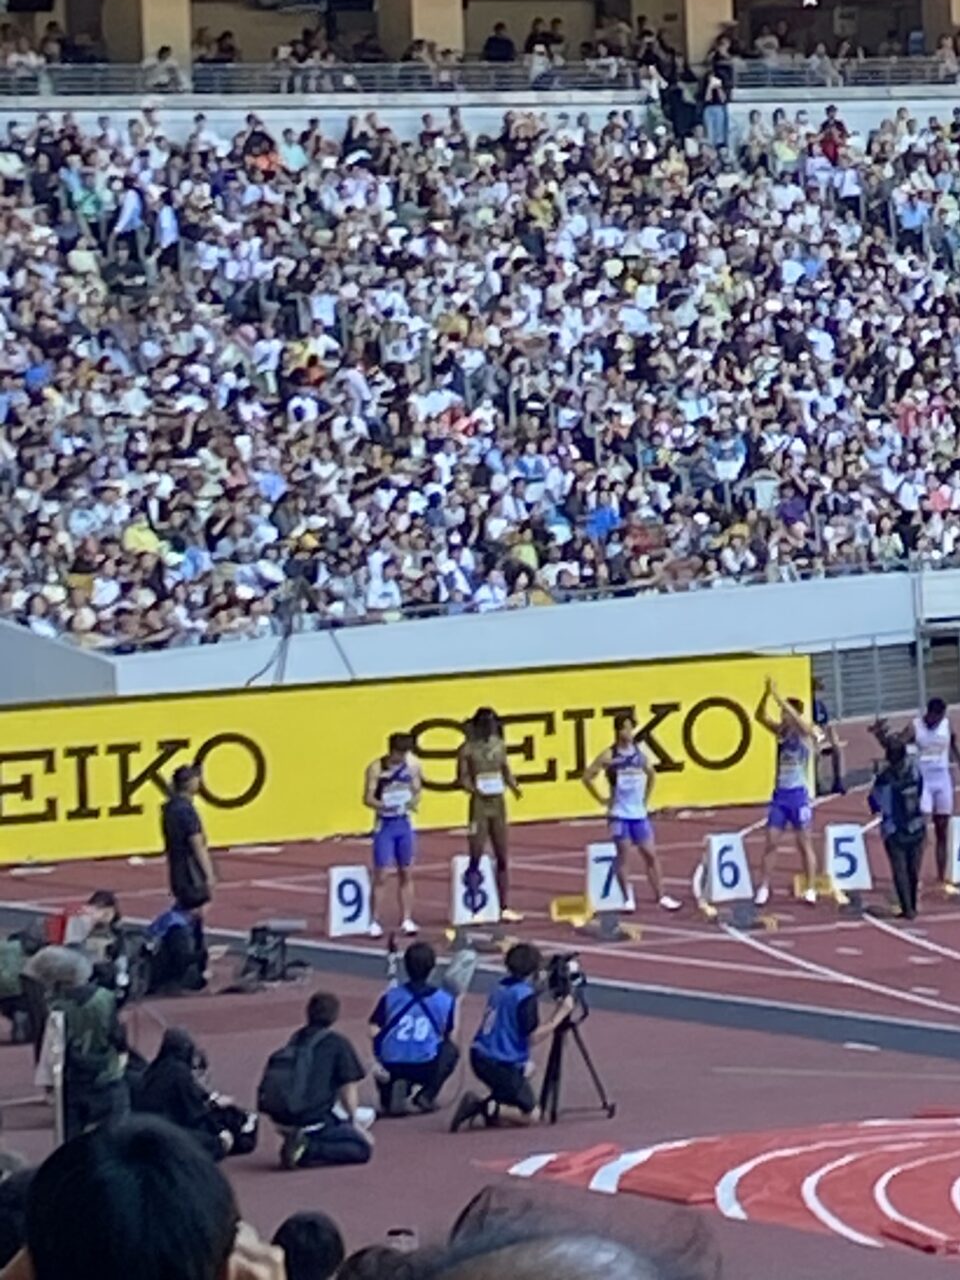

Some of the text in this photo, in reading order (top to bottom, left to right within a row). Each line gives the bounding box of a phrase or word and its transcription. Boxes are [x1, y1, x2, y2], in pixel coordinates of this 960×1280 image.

[410, 697, 752, 792] SEIKO
[595, 857, 618, 899] 7
[718, 846, 740, 888] 6
[834, 837, 858, 879] 5
[337, 878, 363, 923] 9
